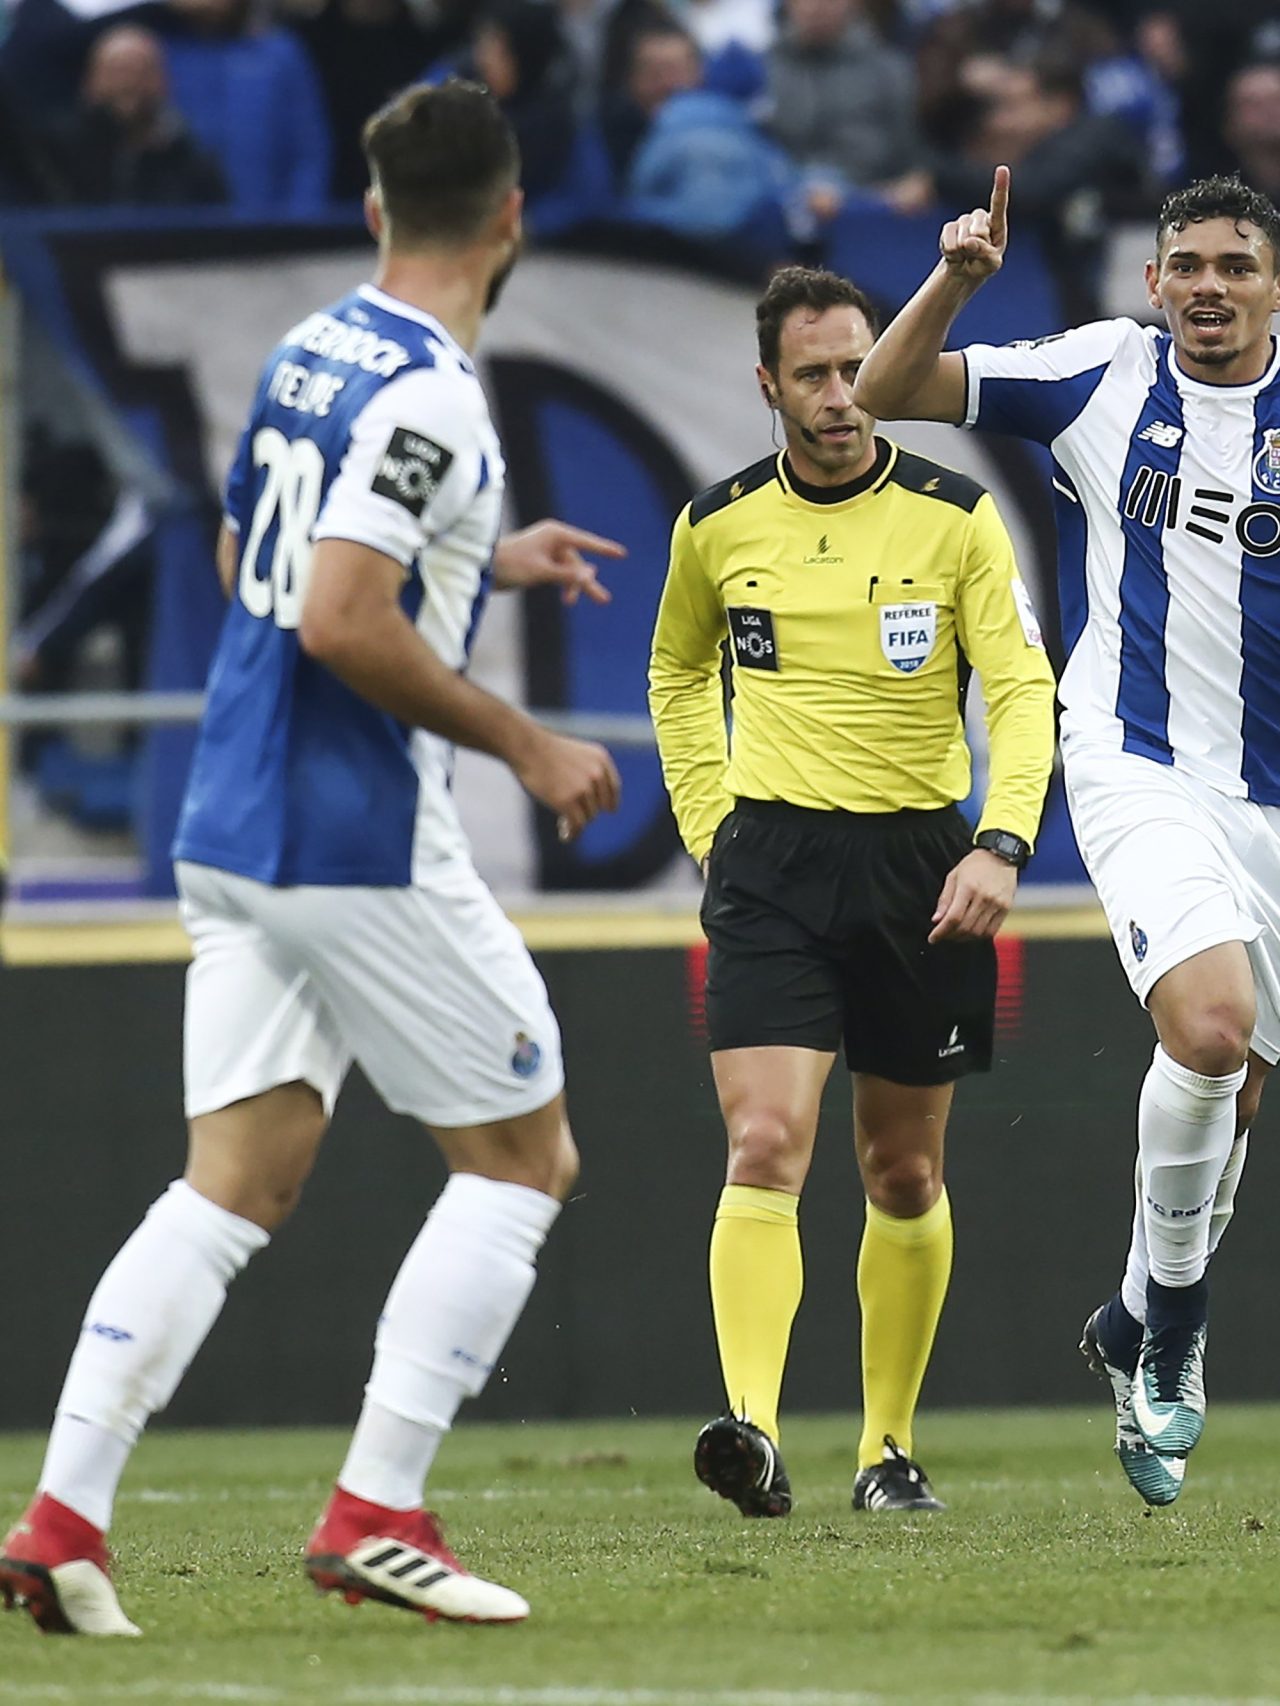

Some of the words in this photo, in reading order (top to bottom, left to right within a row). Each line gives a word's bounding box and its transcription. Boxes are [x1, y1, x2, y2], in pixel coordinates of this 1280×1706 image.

[240, 427, 325, 630] 28
[741, 615, 762, 626] LIGA
[884, 607, 931, 621] REFEREE
[736, 631, 774, 659] NOS
[888, 629, 929, 648] FIFA
